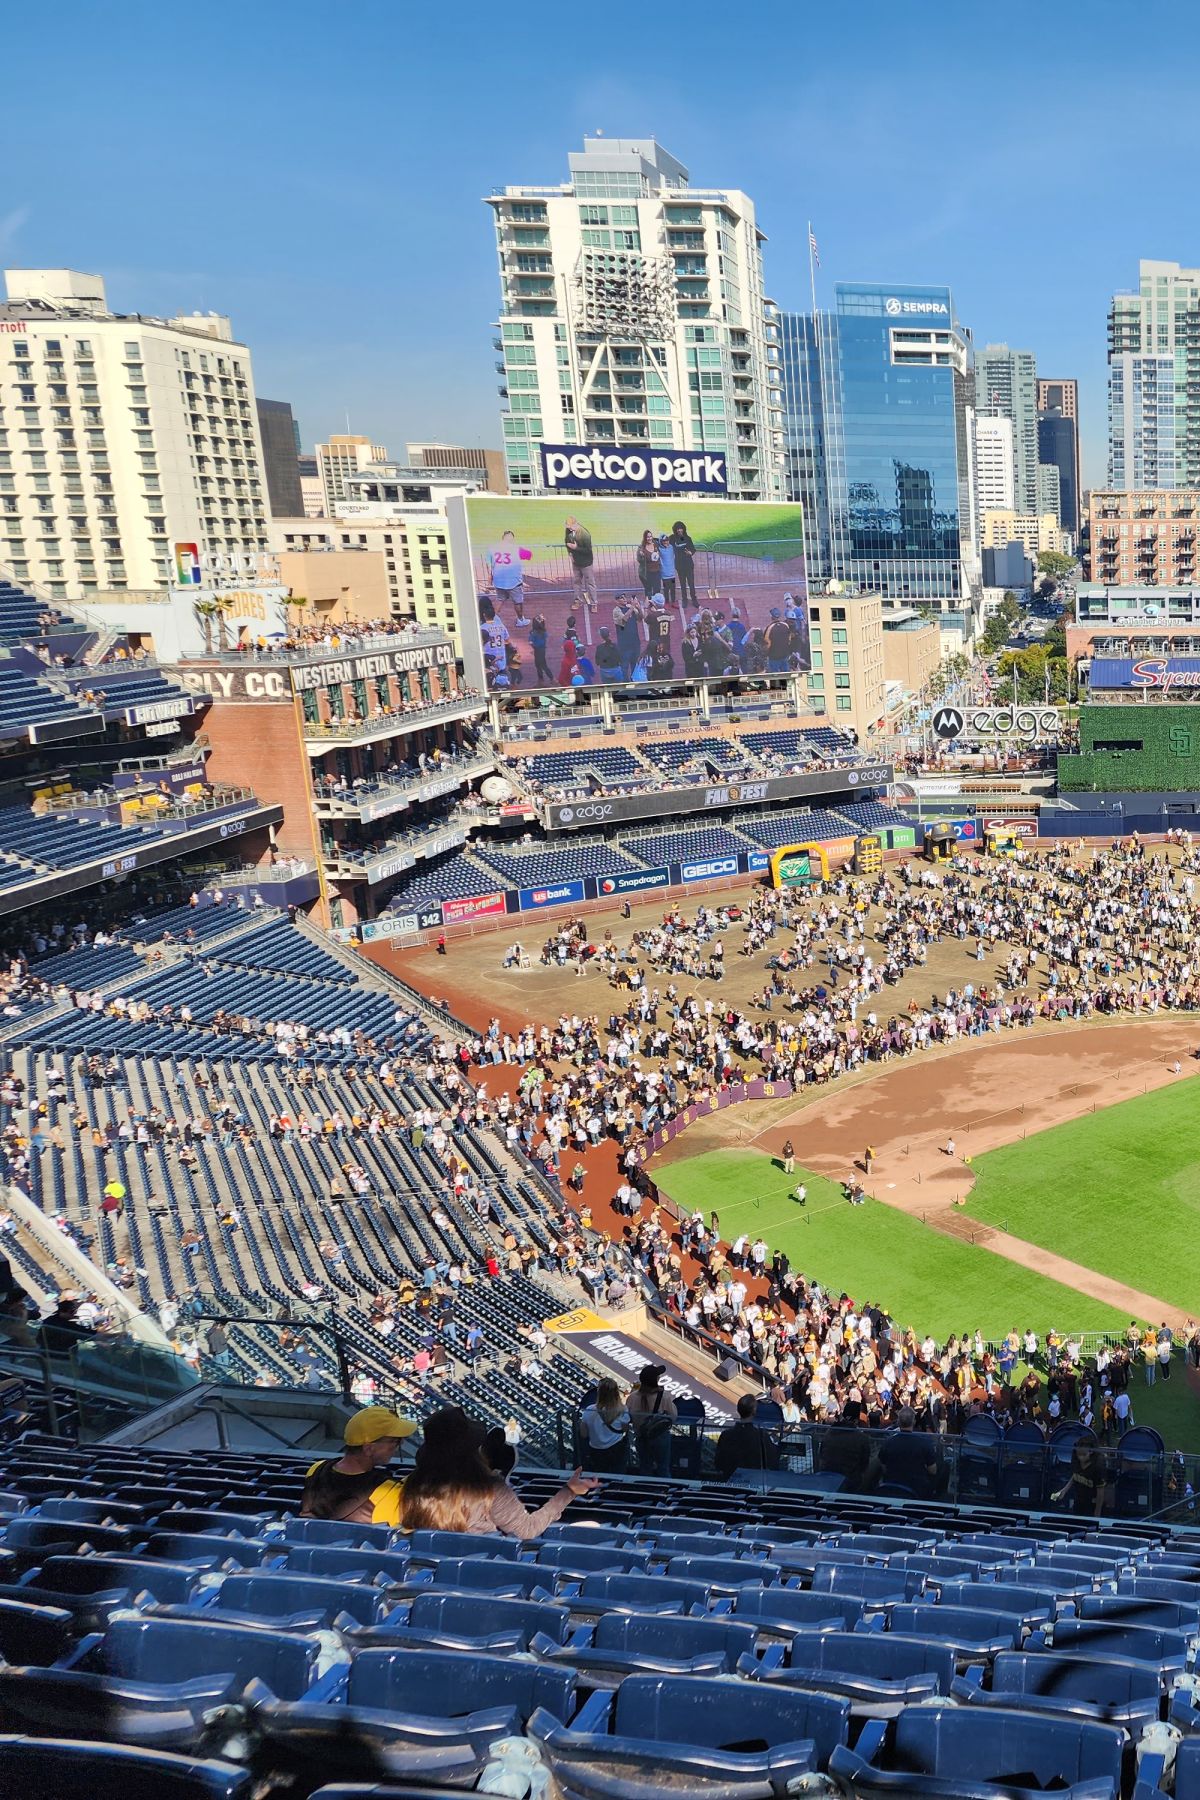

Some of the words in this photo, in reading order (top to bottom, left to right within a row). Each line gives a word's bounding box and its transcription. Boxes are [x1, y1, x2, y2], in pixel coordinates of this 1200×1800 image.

[903, 302, 948, 313] SEMPRA
[545, 450, 647, 487] petco
[651, 456, 726, 490] park
[292, 662, 353, 691] WESTERN
[355, 654, 395, 679] METAL
[395, 648, 433, 672] SUPPLY
[972, 703, 1060, 743] edge
[860, 768, 888, 784] edge
[704, 788, 729, 806] FAN
[740, 782, 770, 799] FEST
[576, 803, 614, 820] edge
[228, 821, 247, 835] edge
[683, 855, 737, 880] GEICO
[618, 873, 666, 888] Snapdragon
[534, 891, 547, 901] us
[547, 883, 572, 899] bank
[381, 917, 416, 933] ORIS
[421, 912, 441, 928] 342
